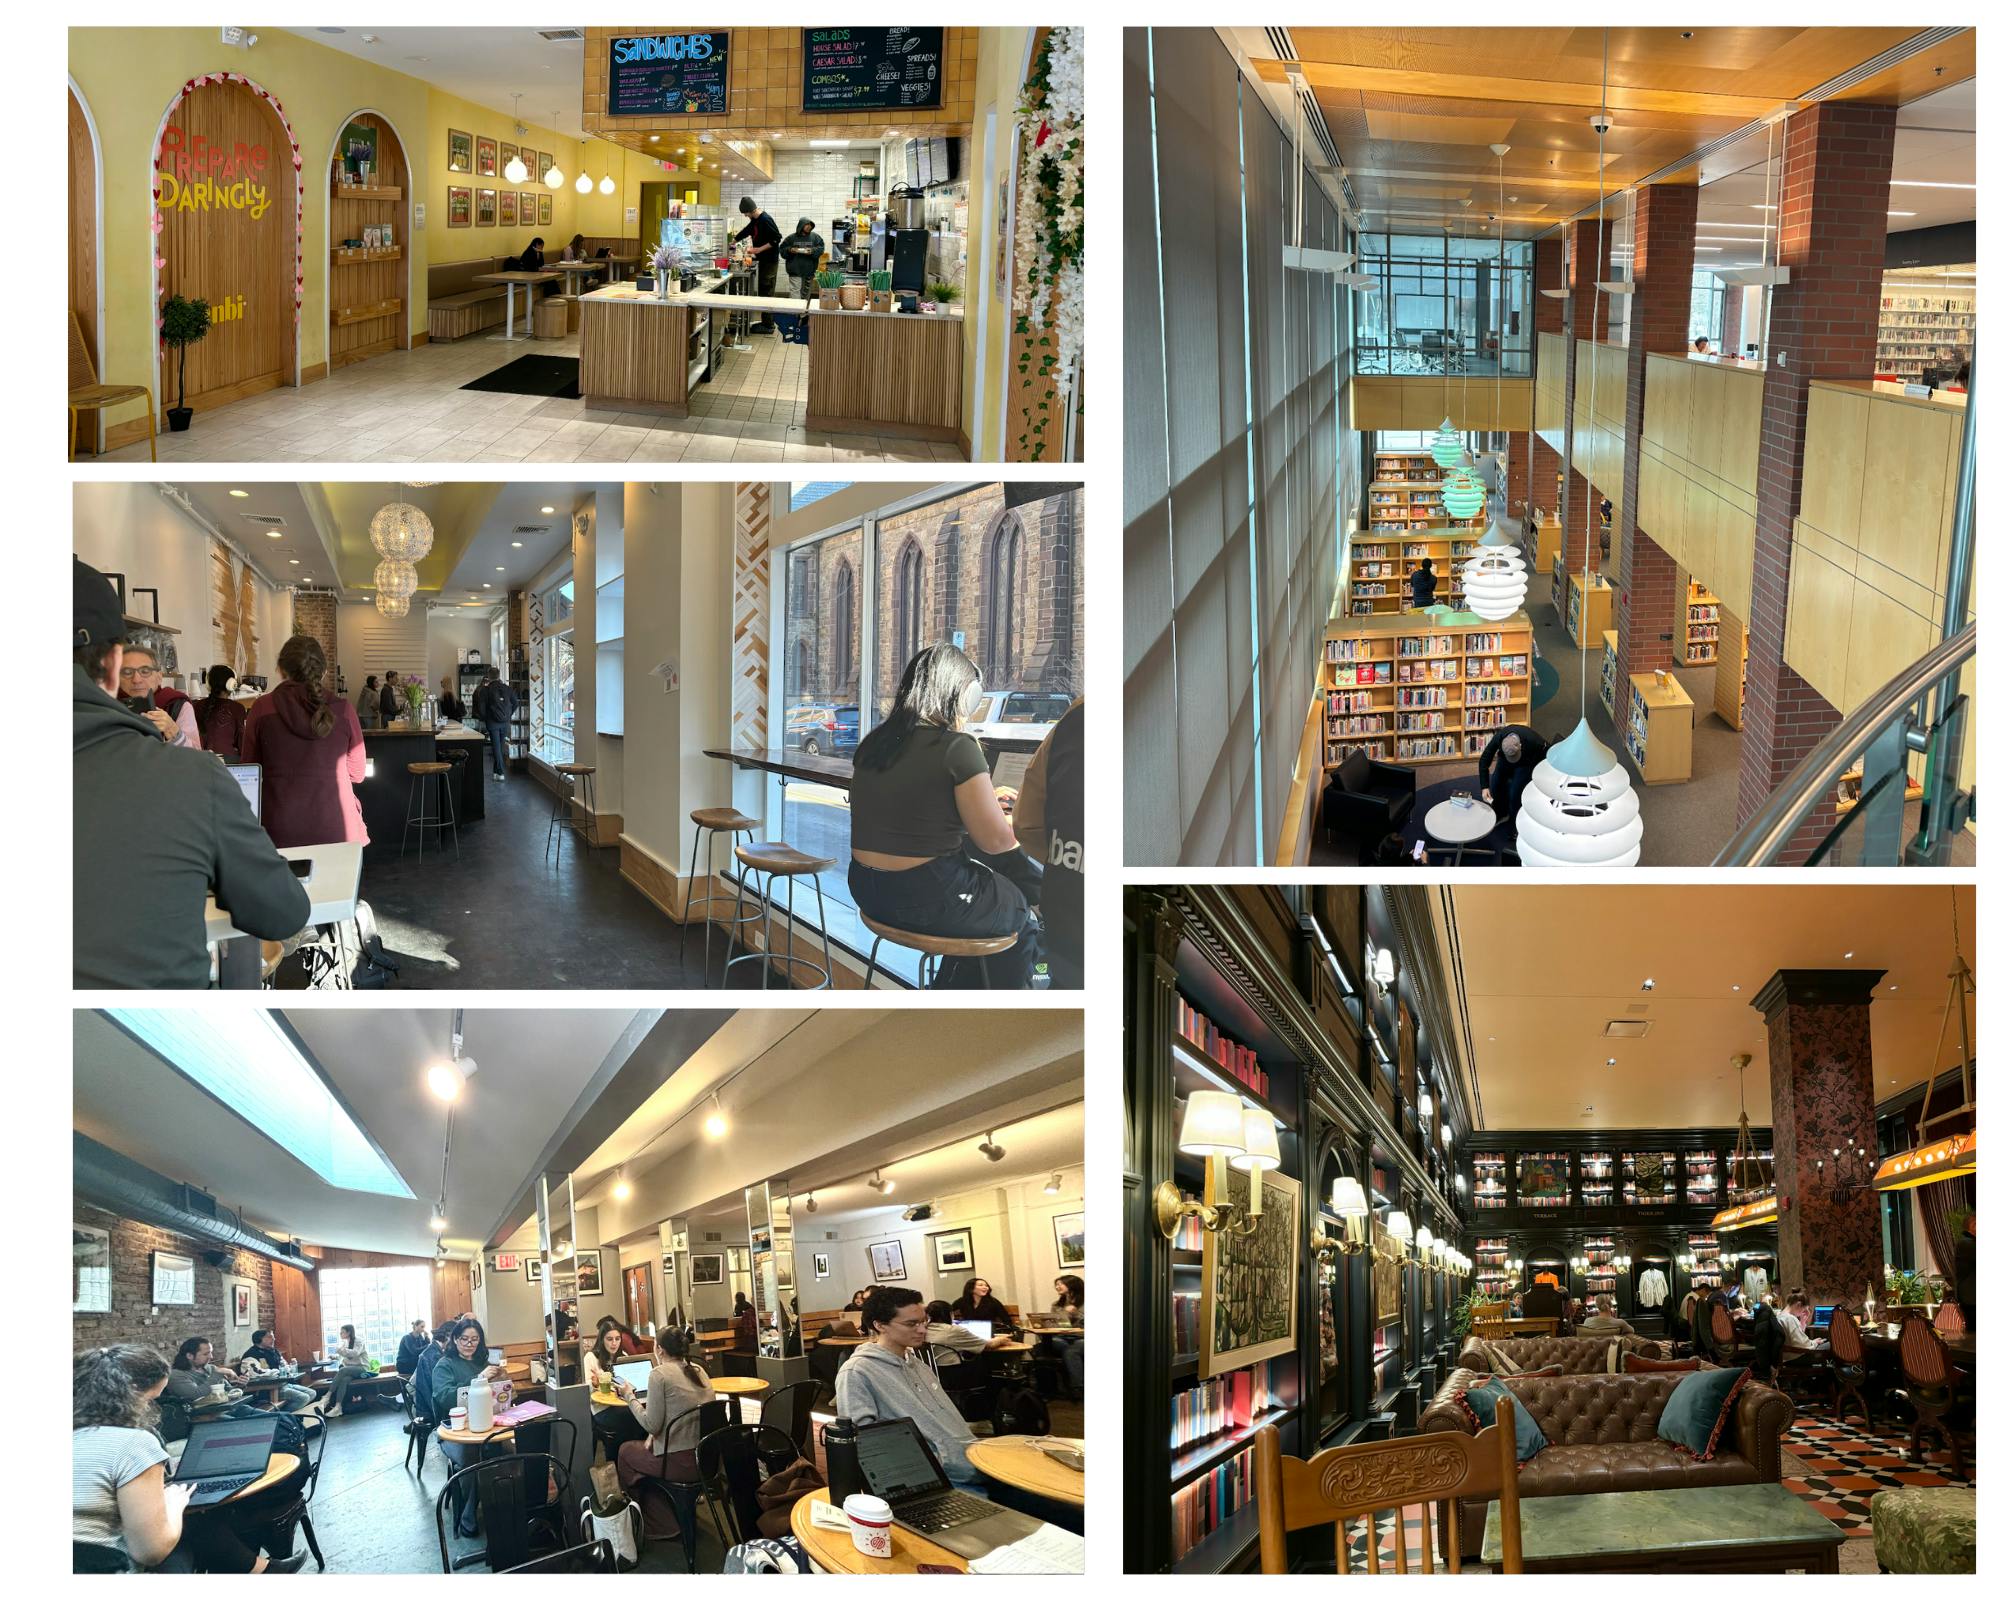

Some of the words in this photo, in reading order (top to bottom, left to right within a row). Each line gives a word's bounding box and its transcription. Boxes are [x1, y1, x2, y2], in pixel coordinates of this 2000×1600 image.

[813, 43, 832, 52] HOUSE
[813, 56, 836, 67] CAESAR
[906, 53, 937, 63] SPREADS!
[876, 72, 900, 80] CHEESE!
[900, 82, 931, 92] VEGGIES!
[500, 1255, 516, 1268] EXIT
